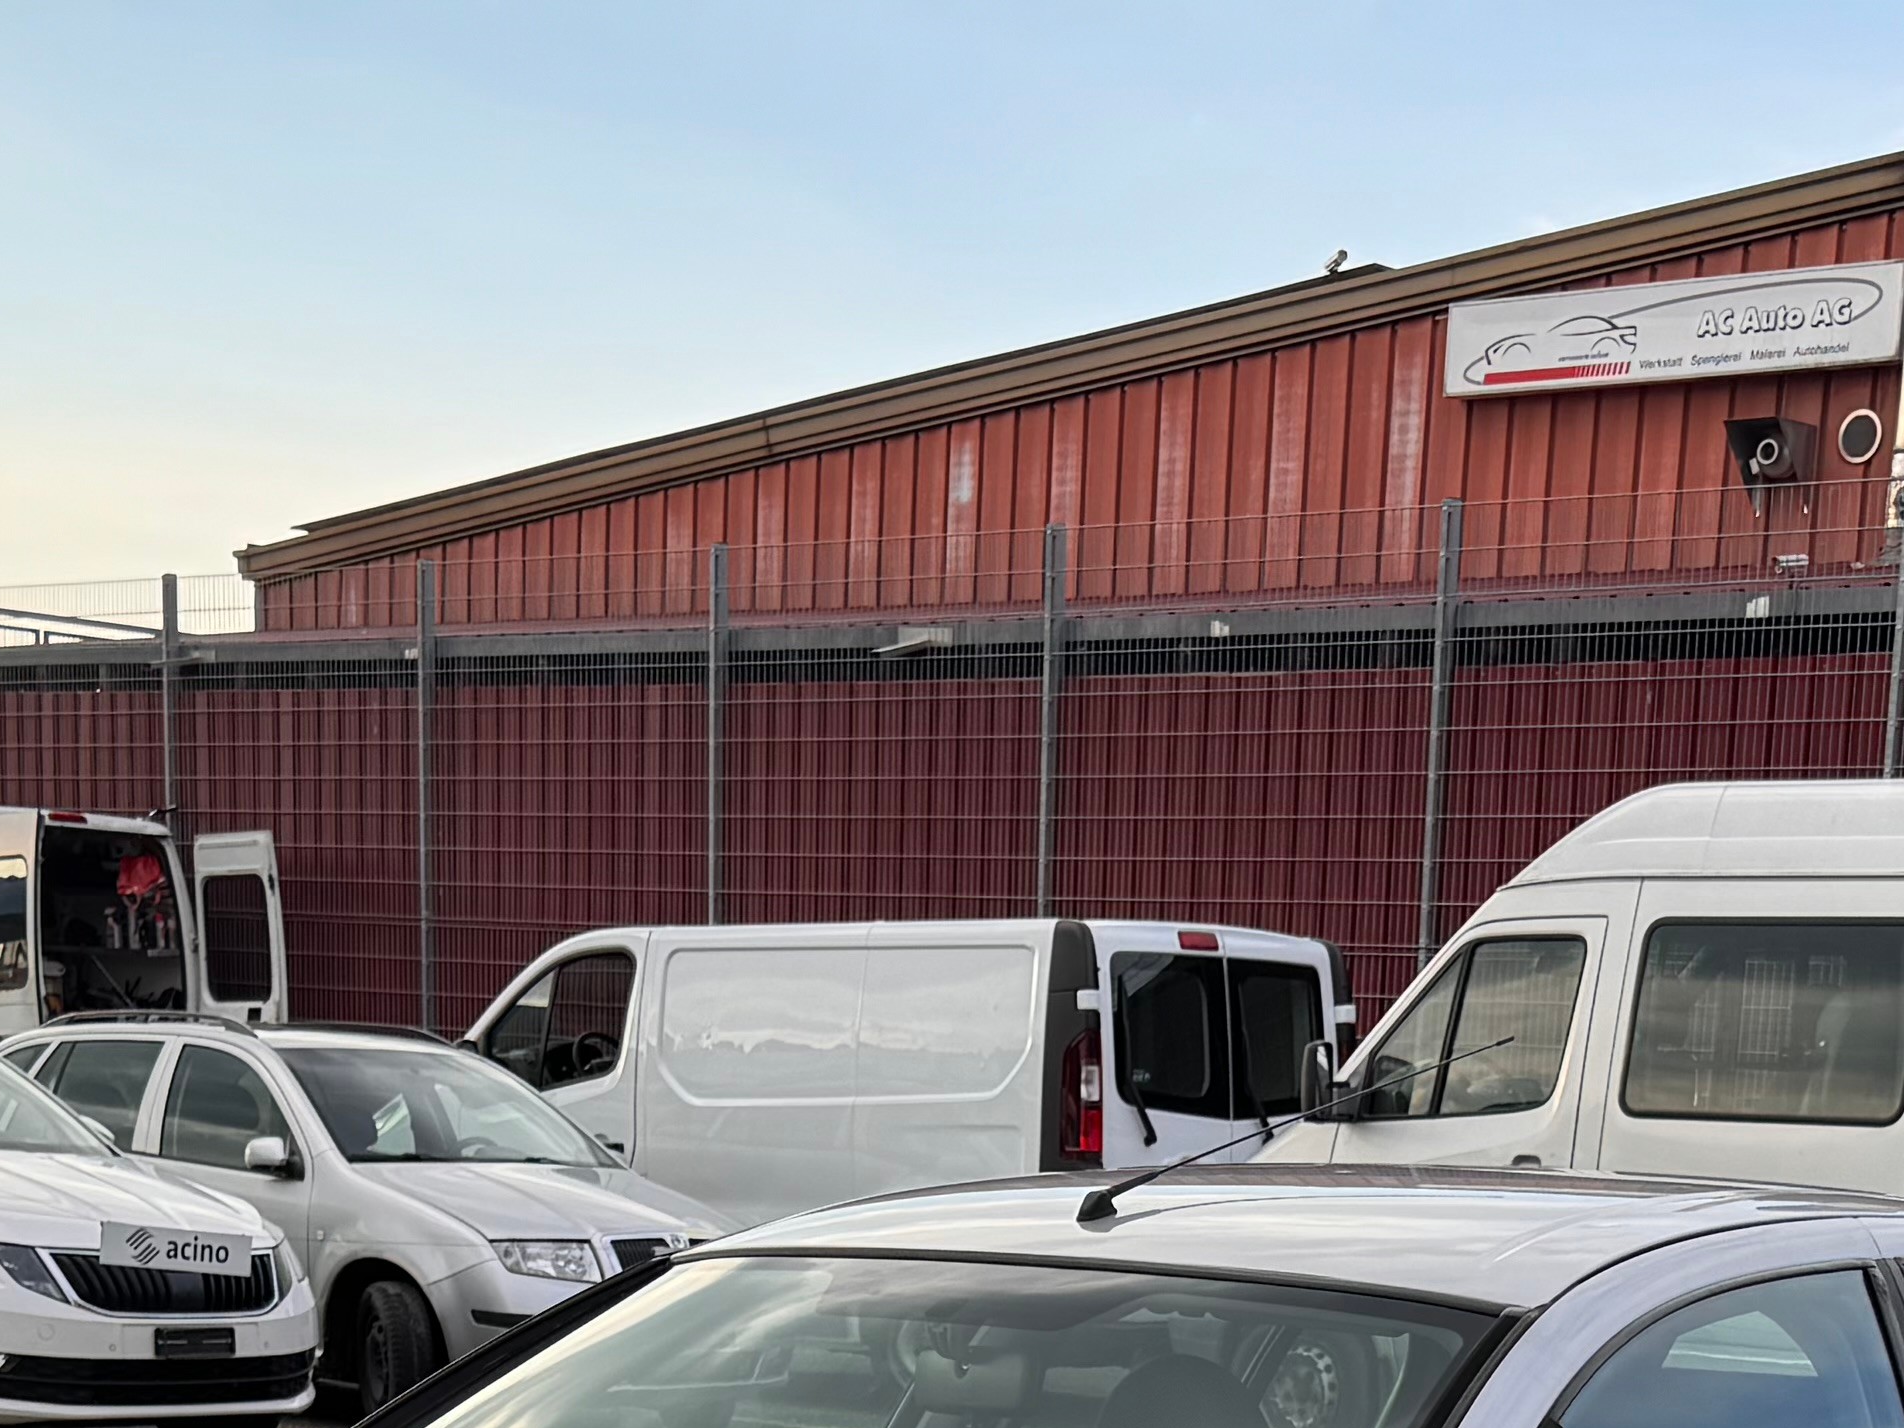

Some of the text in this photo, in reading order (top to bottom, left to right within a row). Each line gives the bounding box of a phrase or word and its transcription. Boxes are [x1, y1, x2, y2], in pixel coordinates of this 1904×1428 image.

[1697, 297, 1853, 338] AC Auto AG
[166, 1235, 229, 1264] acino
